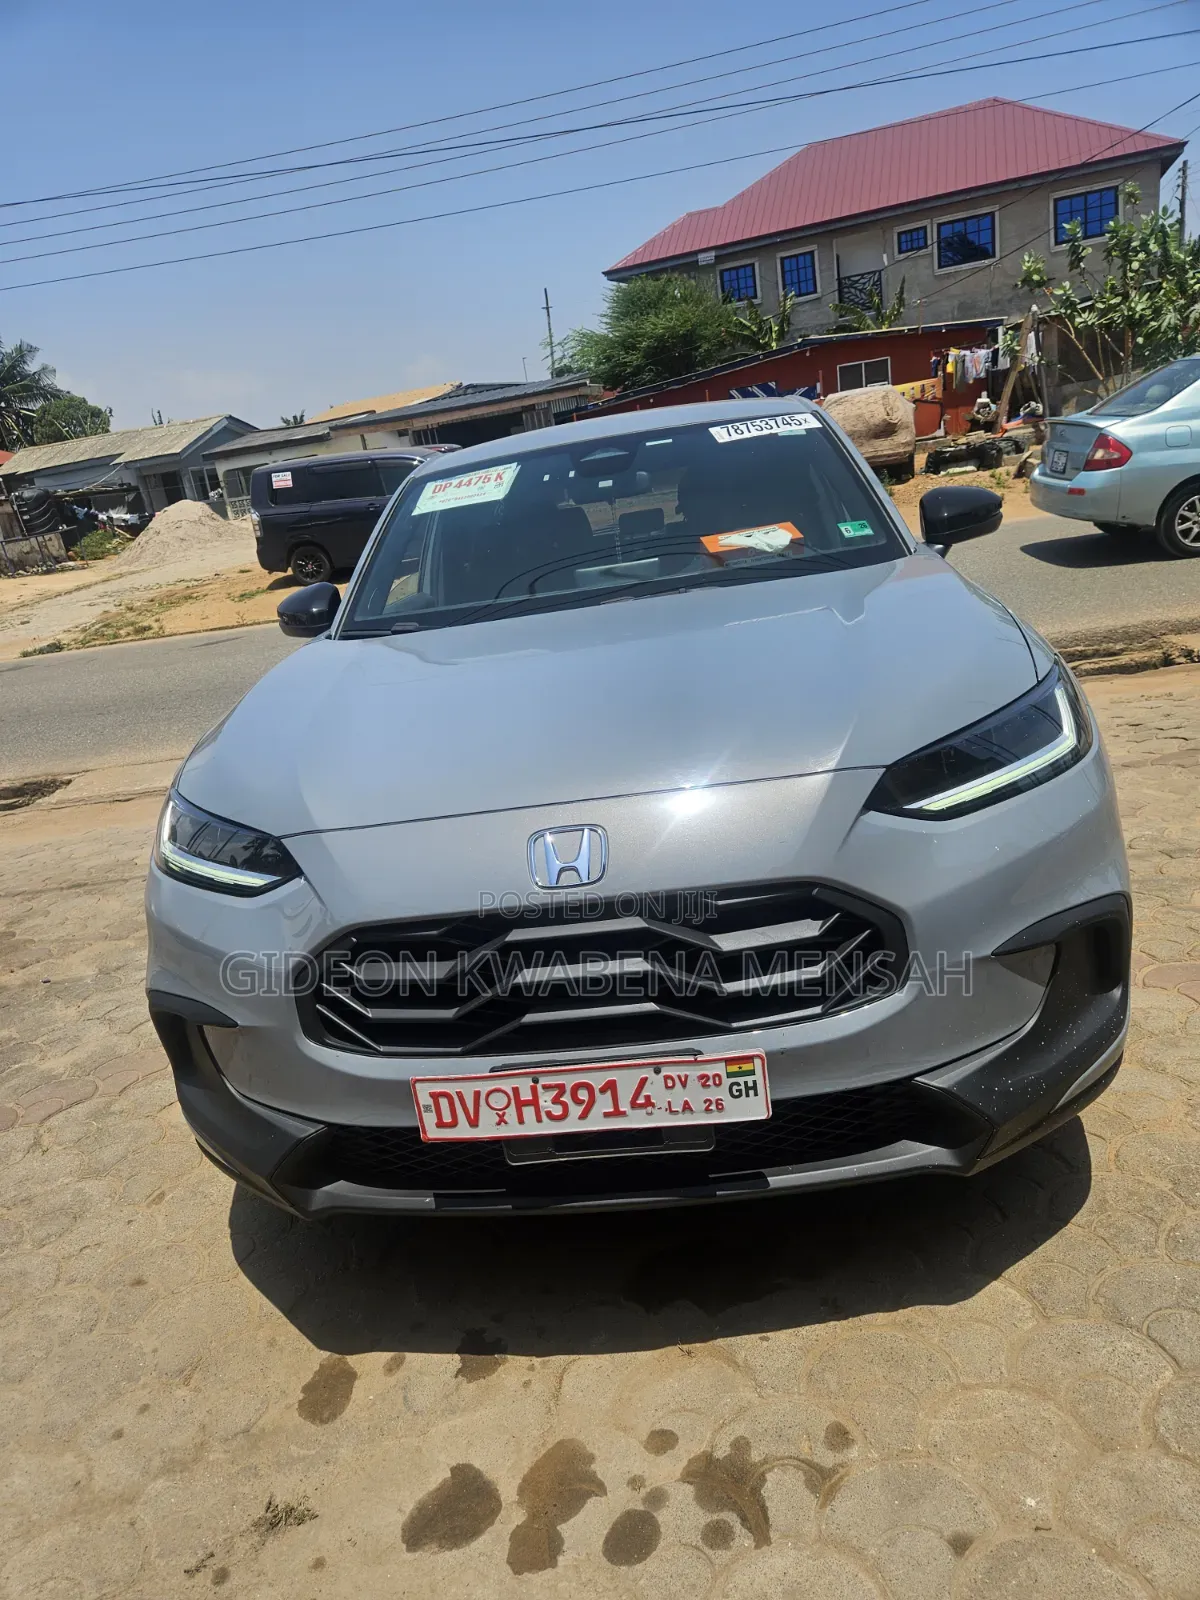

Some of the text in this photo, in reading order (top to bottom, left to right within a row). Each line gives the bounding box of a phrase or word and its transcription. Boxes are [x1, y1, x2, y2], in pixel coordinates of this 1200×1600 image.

[720, 416, 802, 437] 78753745
[432, 481, 453, 494] DP
[453, 473, 493, 488] 4475
[494, 470, 506, 482] K
[663, 1072, 723, 1090] DV 20
[728, 1080, 759, 1099] GH
[667, 1098, 725, 1114] LA 26
